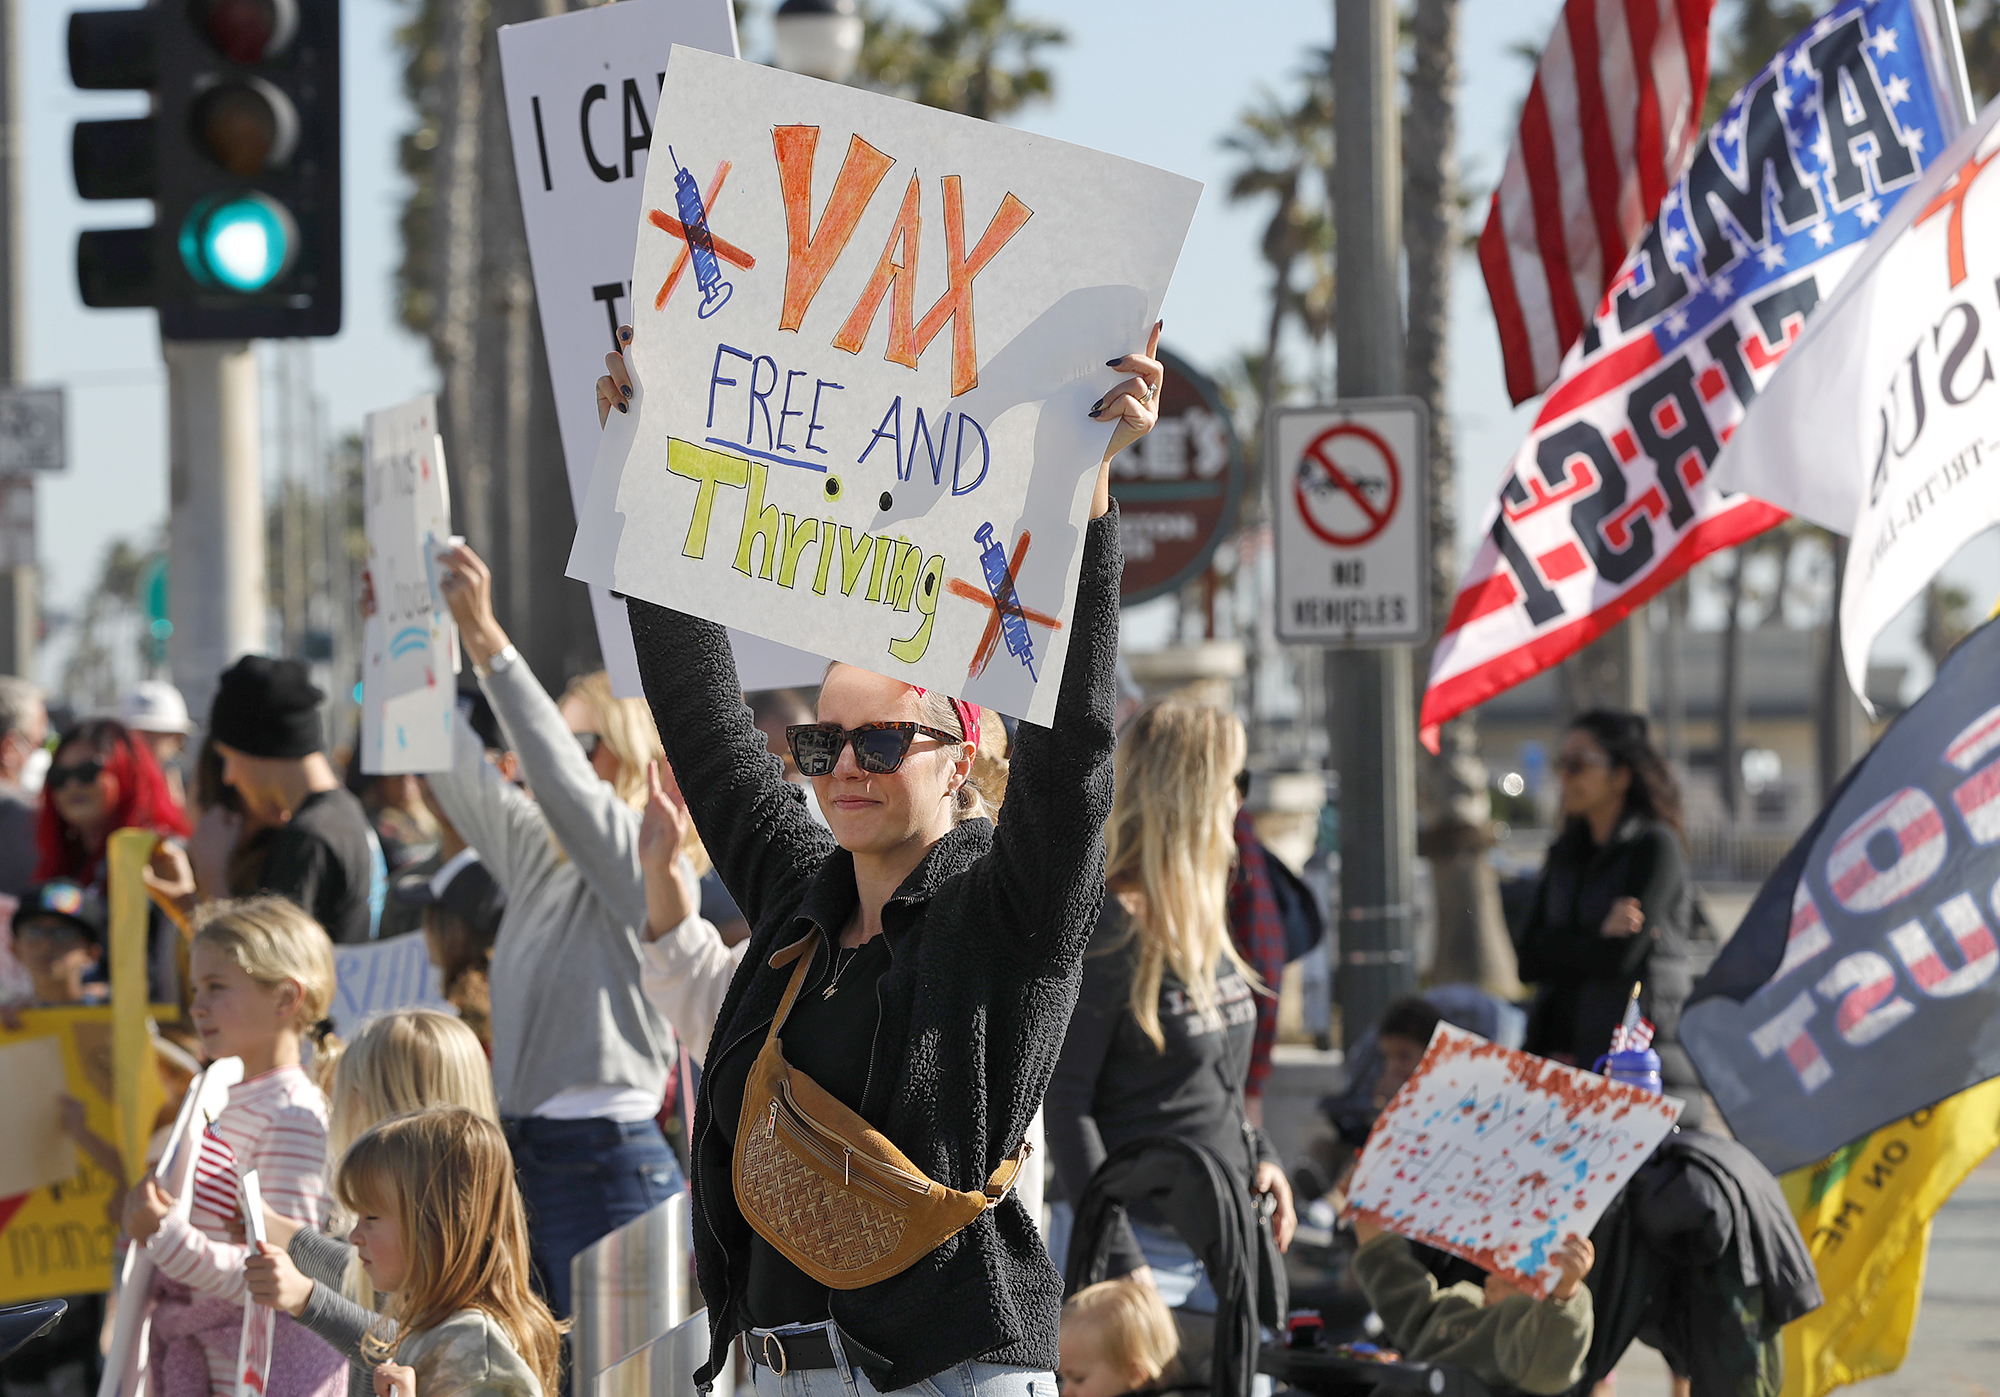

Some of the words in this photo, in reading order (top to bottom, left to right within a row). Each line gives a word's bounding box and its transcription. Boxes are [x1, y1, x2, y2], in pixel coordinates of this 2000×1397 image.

[531, 96, 553, 191] I
[579, 72, 666, 183] CA
[770, 123, 1034, 399] VAX
[705, 343, 845, 455] FREE
[857, 396, 990, 495] AND
[666, 436, 945, 664] Thriving
[1292, 595, 1405, 625] VEHICLES
[1332, 559, 1364, 586] NO
